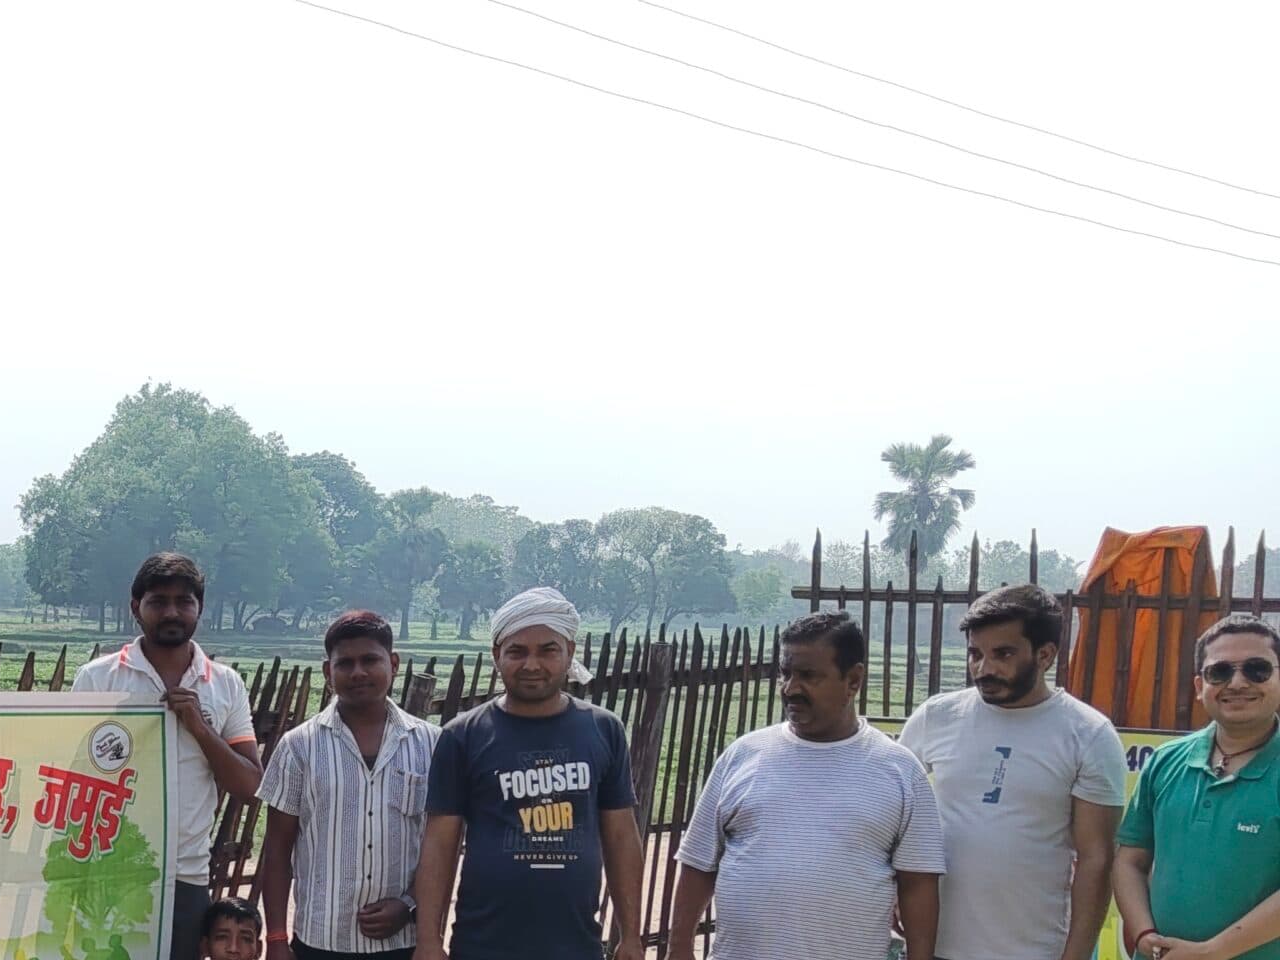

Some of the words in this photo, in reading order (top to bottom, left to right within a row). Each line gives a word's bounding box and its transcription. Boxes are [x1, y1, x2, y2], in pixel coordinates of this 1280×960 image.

[498, 761, 591, 801] FOCUSED
[33, 765, 136, 860] जमुई
[518, 801, 574, 834] YOUR
